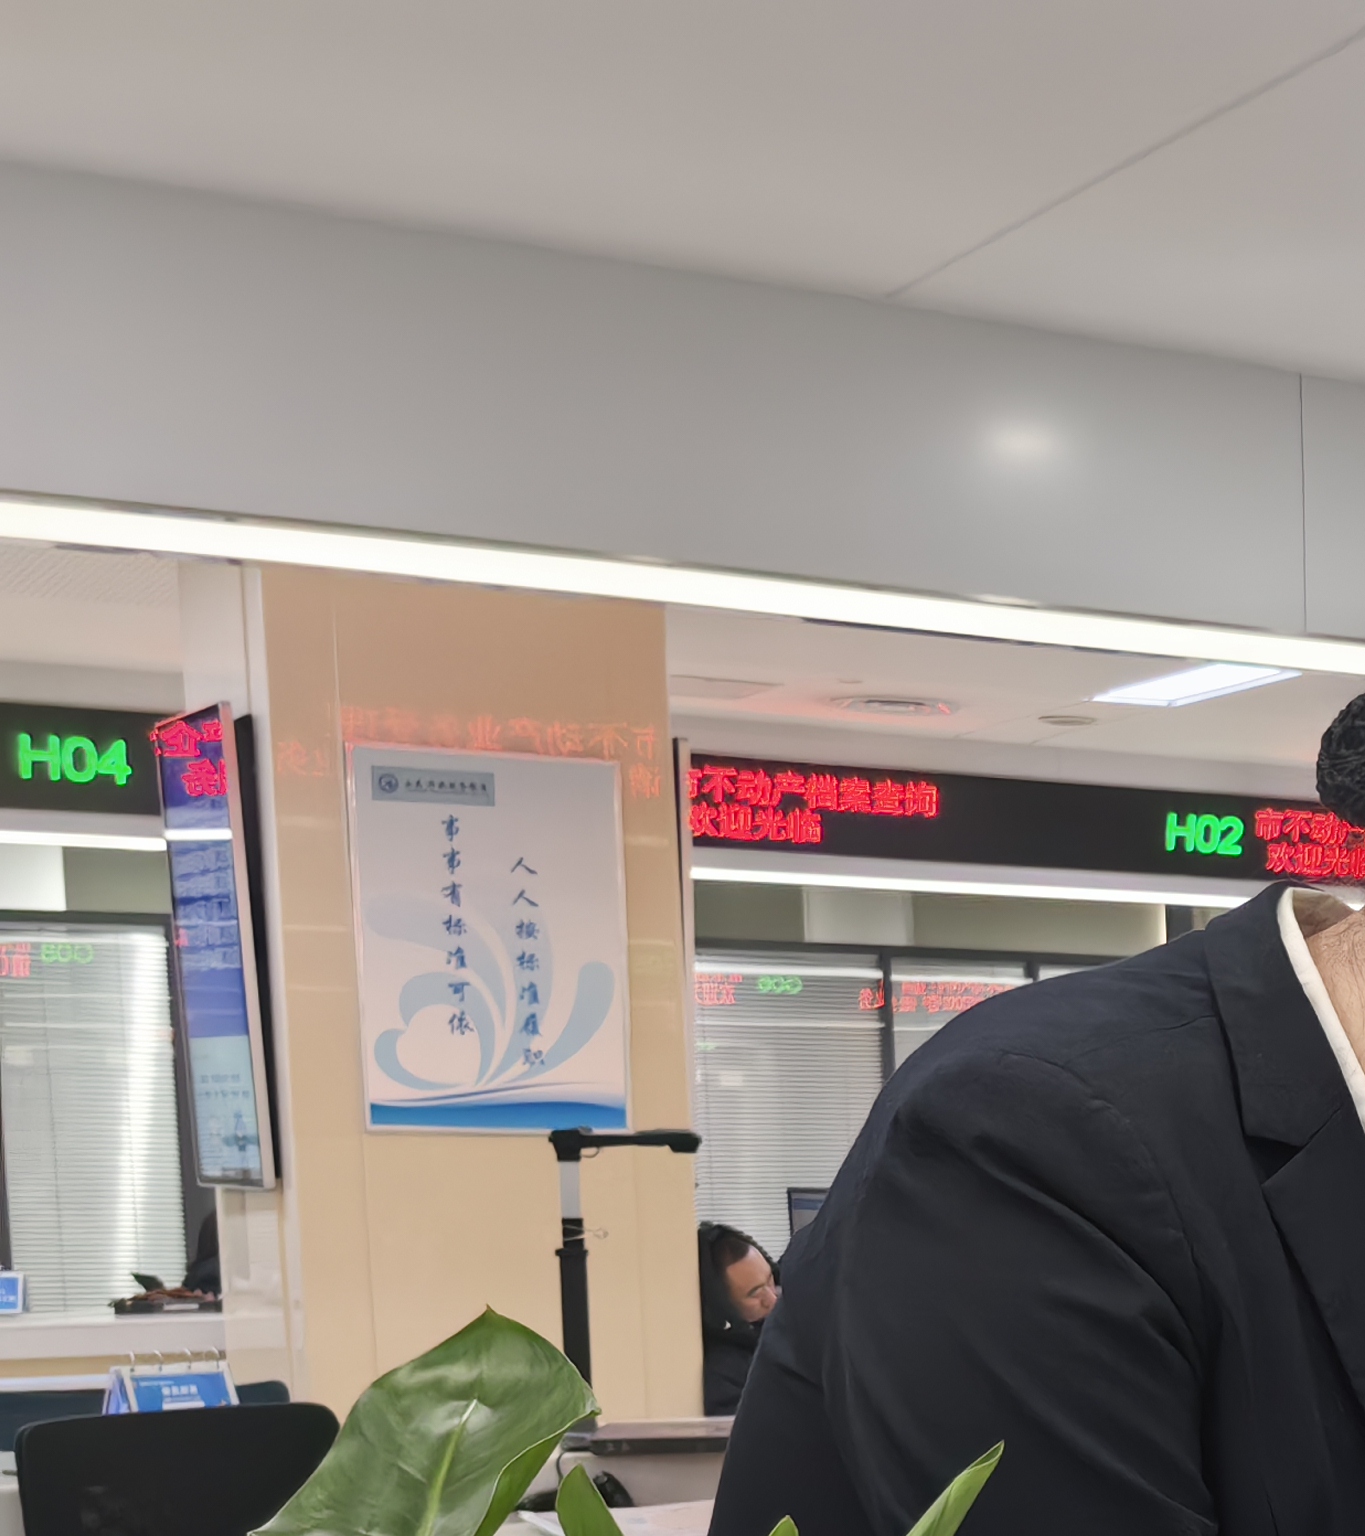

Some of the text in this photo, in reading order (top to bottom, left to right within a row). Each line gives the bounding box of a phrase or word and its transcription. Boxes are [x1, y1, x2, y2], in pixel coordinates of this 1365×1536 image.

[17, 732, 132, 785] H04
[688, 801, 822, 844] 欢迎光临
[1164, 811, 1245, 856] H02
[440, 814, 475, 1036] 事事有标准可依
